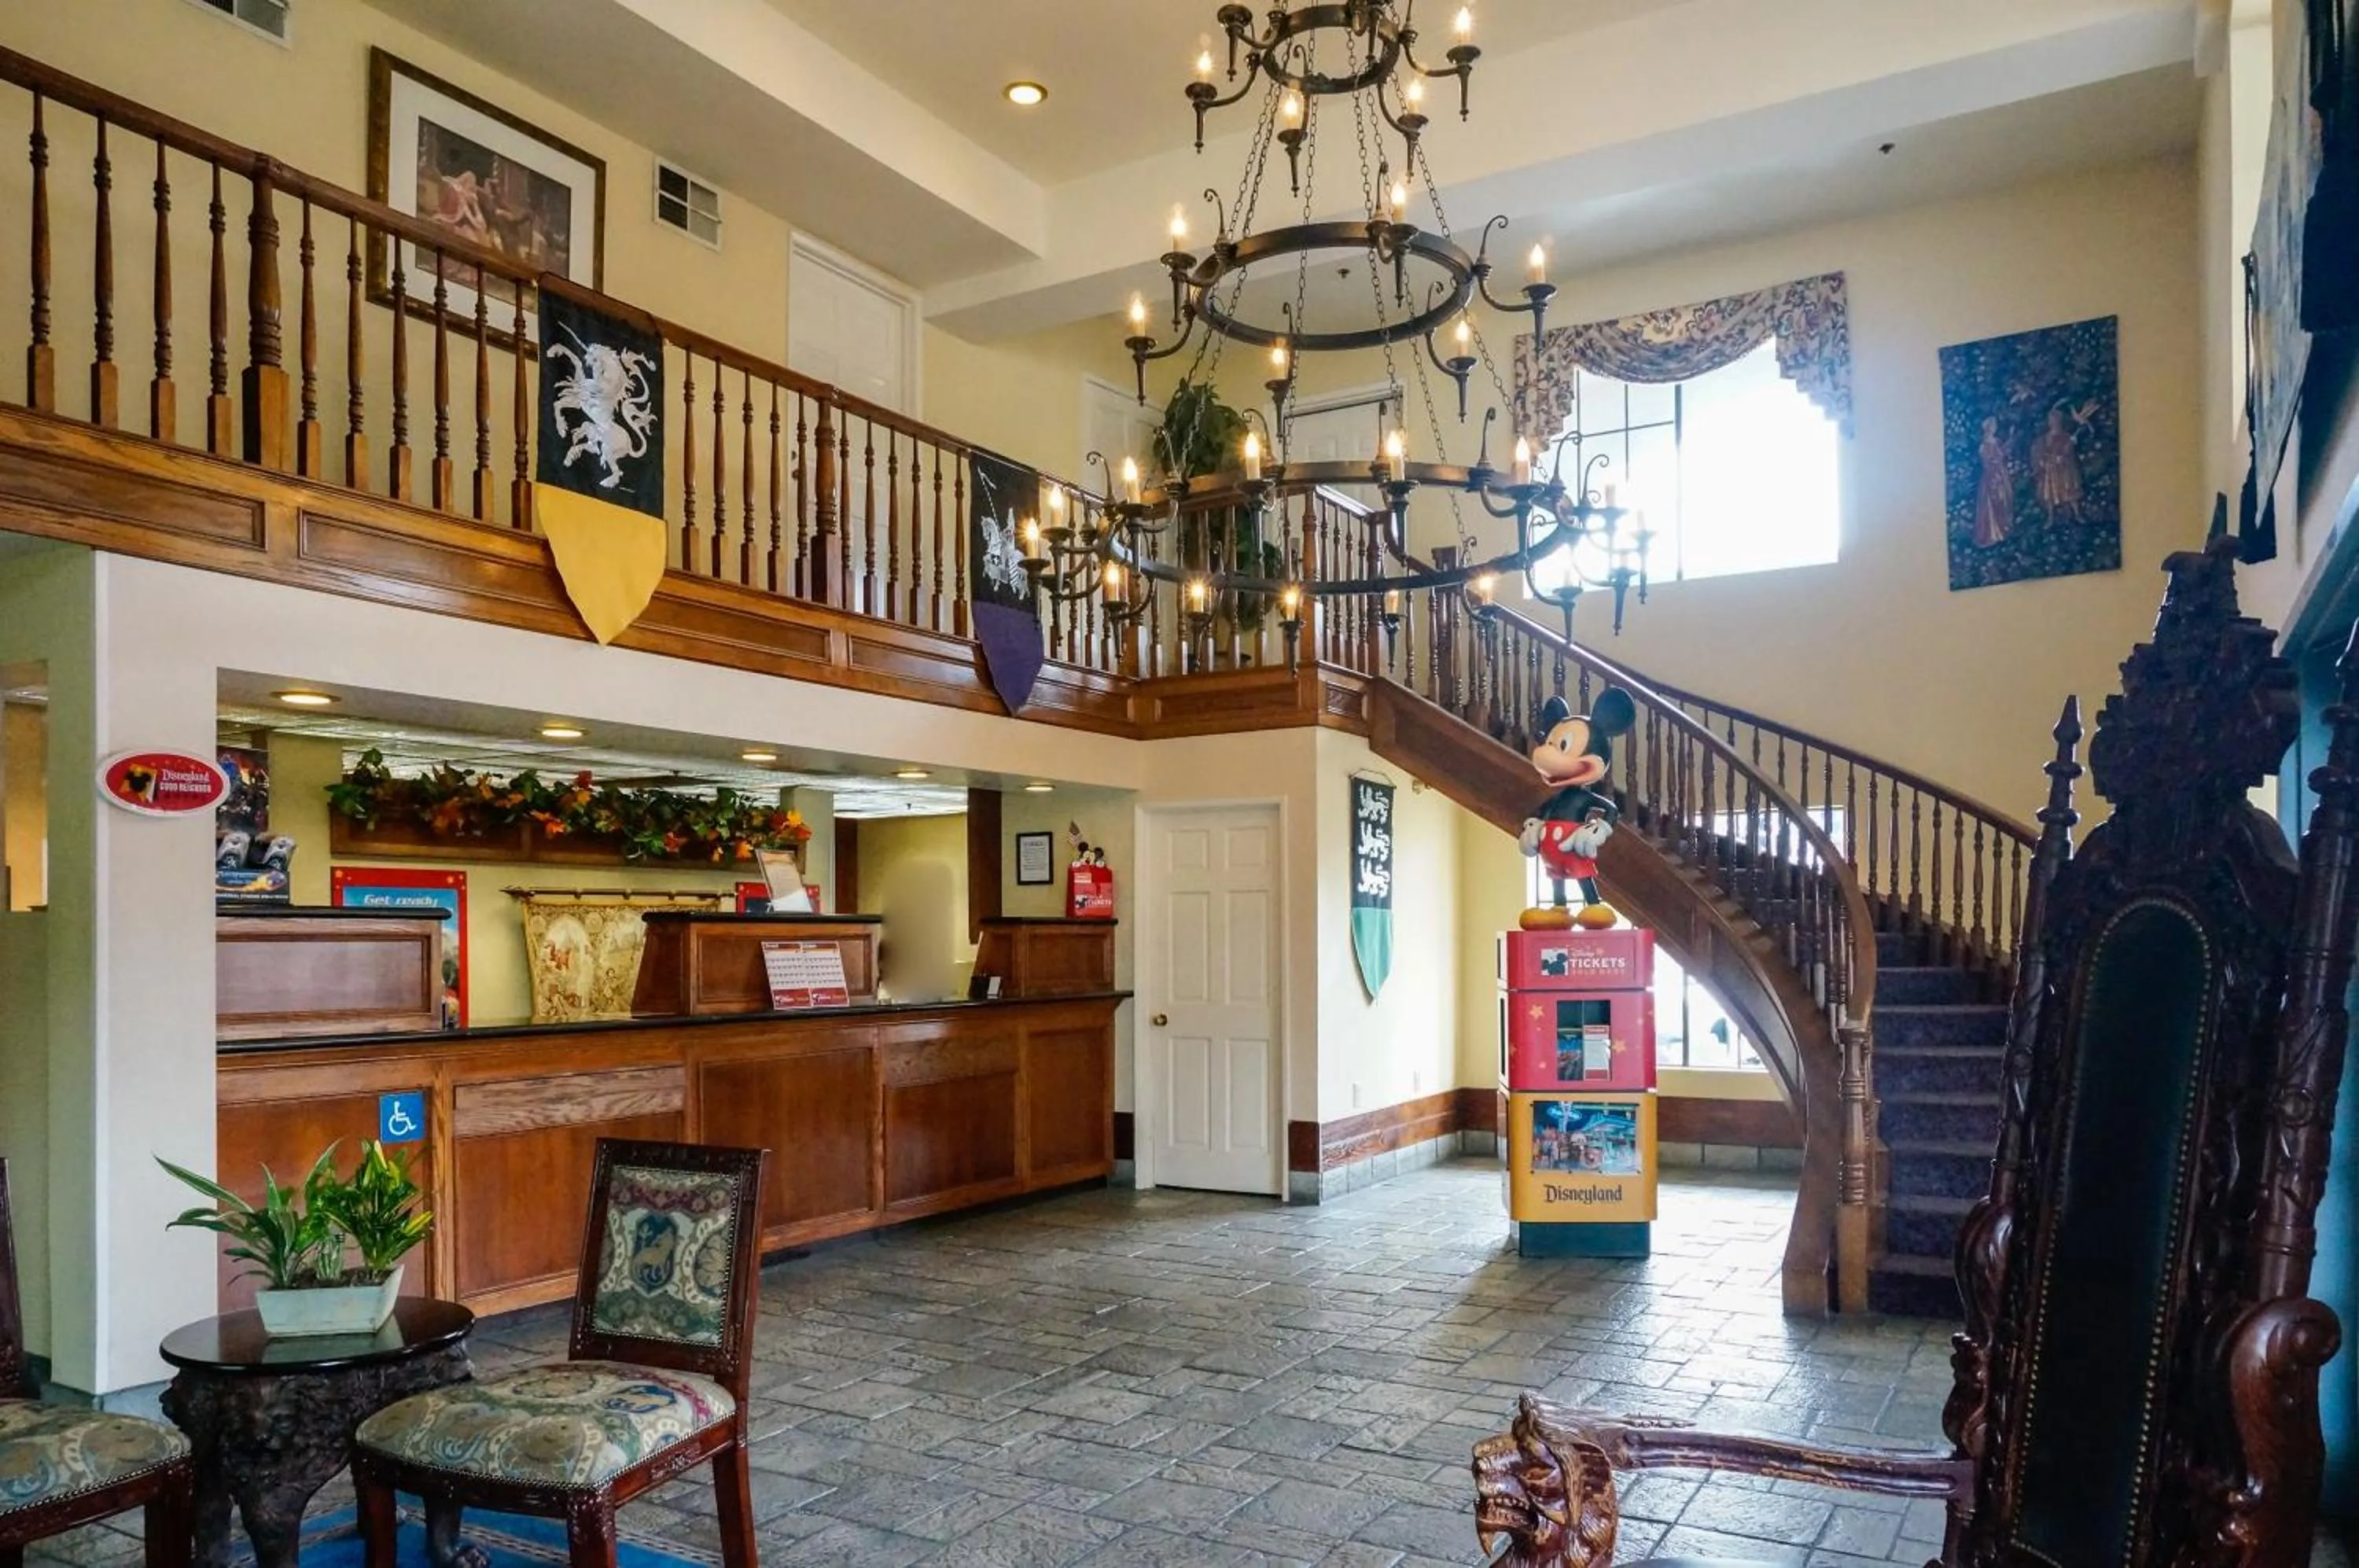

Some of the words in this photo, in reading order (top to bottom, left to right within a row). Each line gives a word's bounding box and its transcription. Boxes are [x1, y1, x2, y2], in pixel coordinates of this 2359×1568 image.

[364, 895, 389, 907] Get
[1569, 957, 1626, 969] TICKETS
[1543, 1183, 1623, 1205] Disneyland
